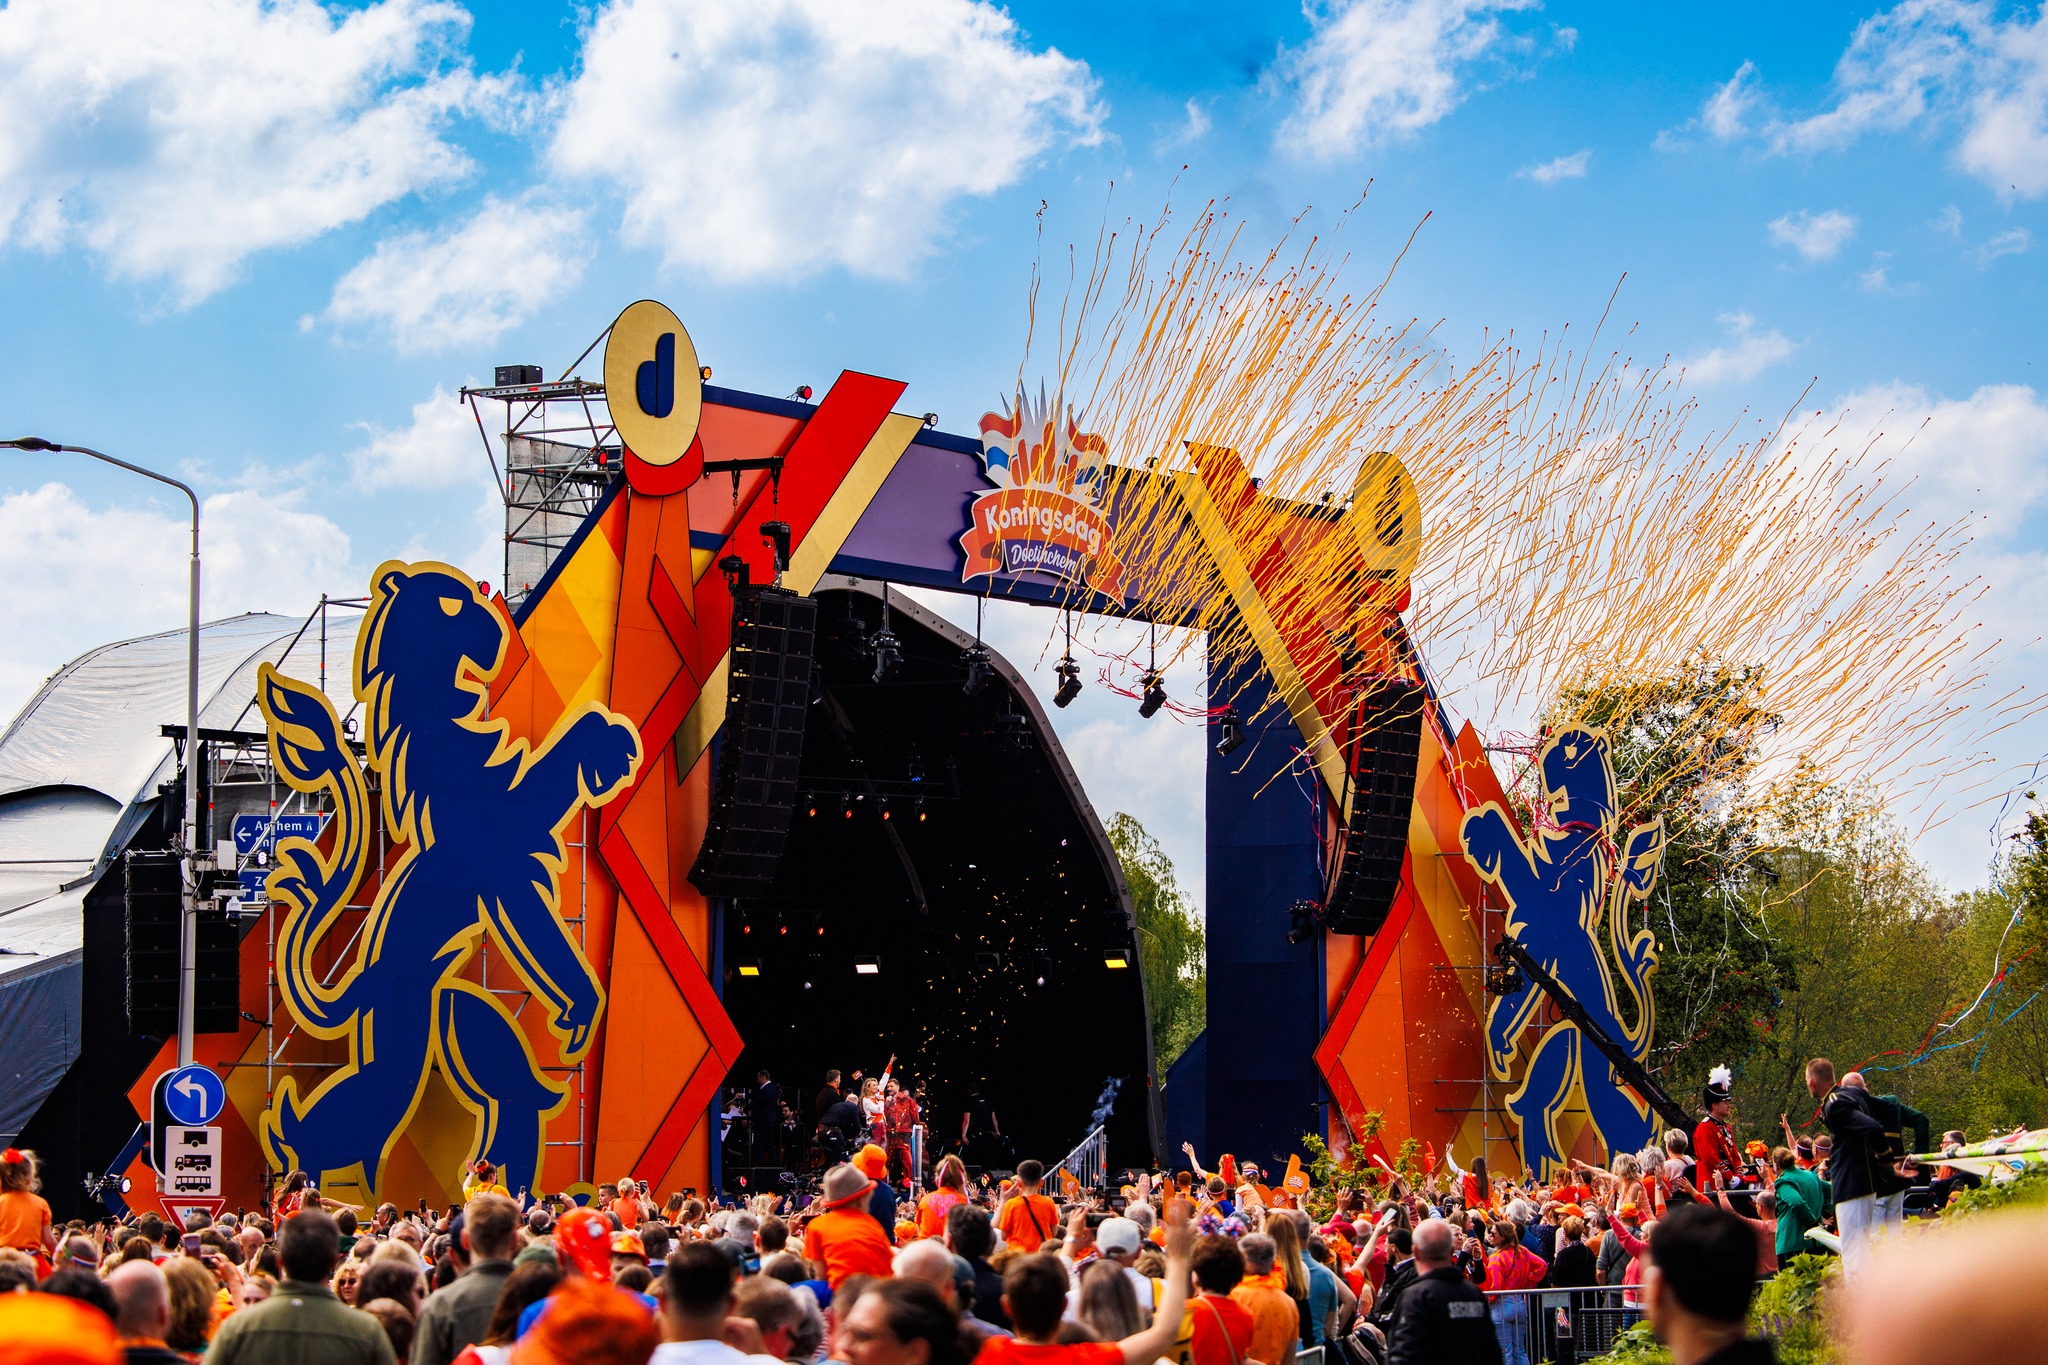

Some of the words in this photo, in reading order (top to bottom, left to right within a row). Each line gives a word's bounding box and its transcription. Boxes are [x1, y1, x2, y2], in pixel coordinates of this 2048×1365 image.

[985, 500, 1101, 555] Koningsdag
[1011, 544, 1077, 573] Doetinchem
[254, 820, 302, 831] Arhem
